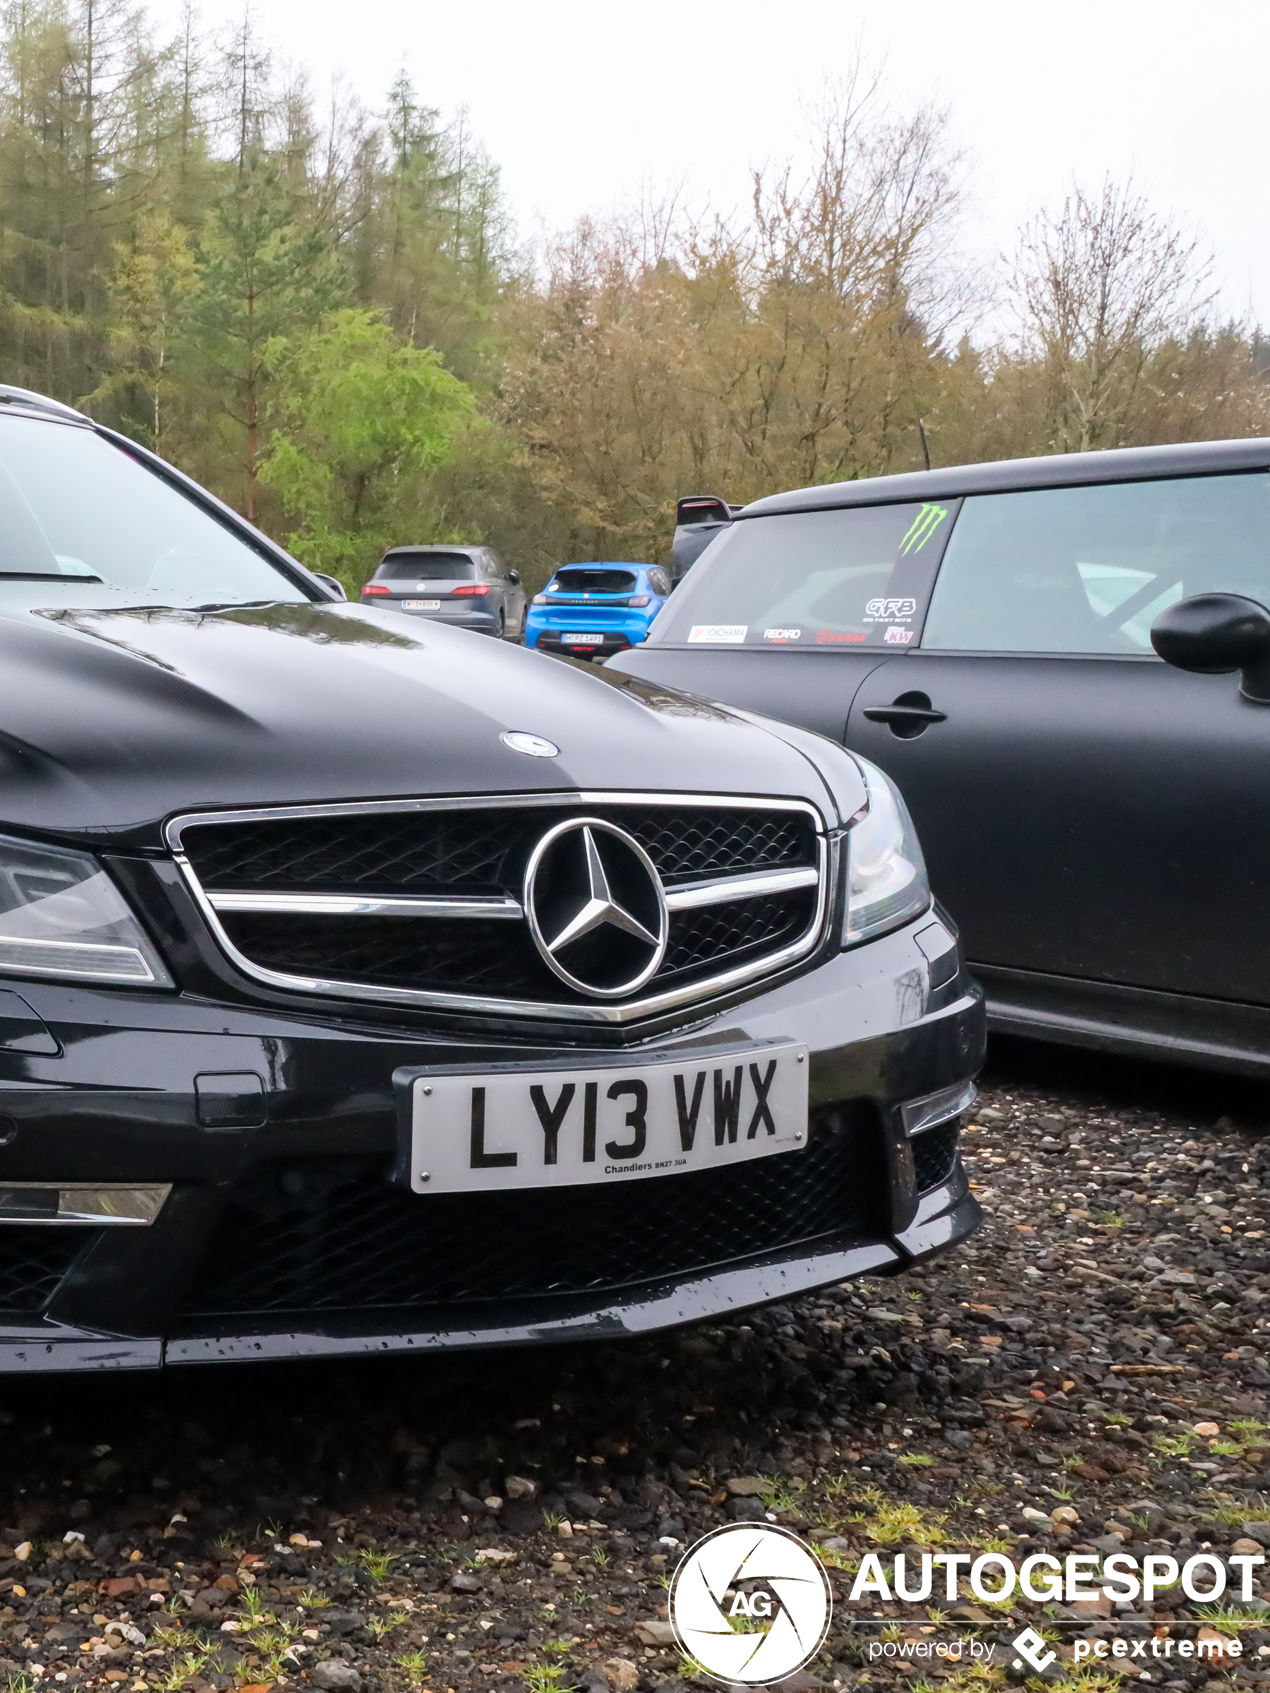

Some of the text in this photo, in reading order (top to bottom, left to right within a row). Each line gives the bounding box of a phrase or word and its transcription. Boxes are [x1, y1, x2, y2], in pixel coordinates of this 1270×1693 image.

[866, 598, 916, 617] GFB
[706, 628, 744, 637] YOKOHAMA
[763, 629, 801, 639] RECARO
[888, 632, 911, 643] KW
[470, 1059, 778, 1169] LY13 VWX
[604, 1163, 652, 1174] Chandlers
[655, 1161, 672, 1169] BN27
